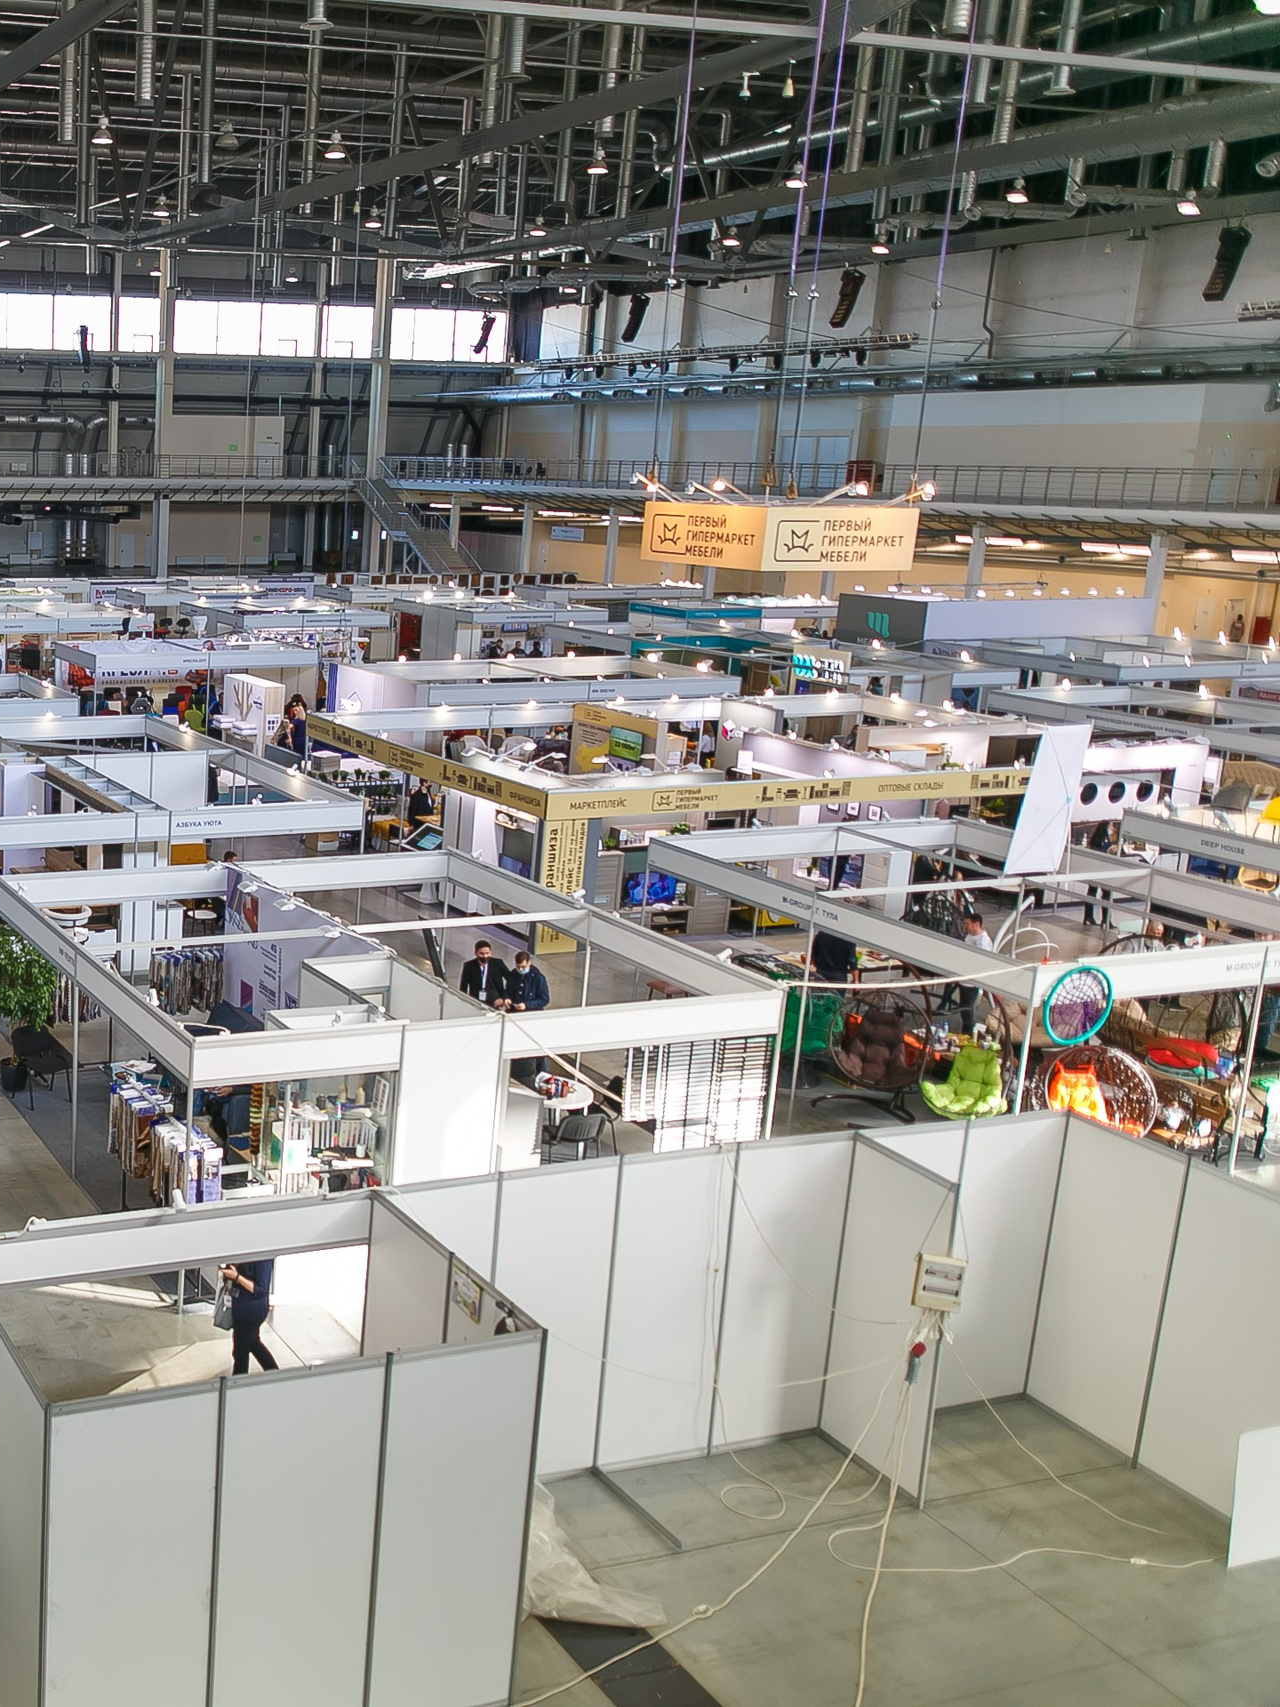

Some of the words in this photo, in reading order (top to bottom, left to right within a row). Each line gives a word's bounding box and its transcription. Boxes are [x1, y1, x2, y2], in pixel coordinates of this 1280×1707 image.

[687, 514, 727, 529] ПЕРВЫЙ
[823, 518, 872, 532] ПЕРВЫЙ
[686, 530, 756, 546] ГИПЕРМАРКЕТ
[821, 535, 905, 548] ГИПЕРМАРКЕТ
[685, 544, 724, 559] МЕБЕЛИ
[820, 550, 867, 562] МЕБЕЛИ
[878, 783, 912, 792] ОПТОВЫЕ
[913, 782, 944, 791] СКЛАДЫ
[509, 791, 541, 808] ФРАНШИЗА
[570, 797, 628, 810] МАРКЕТПЛЕЙС
[676, 795, 719, 803] ГИПЕРМАРКЕТ
[1200, 839, 1220, 849] DEEP
[1221, 844, 1245, 855] HOUSE
[546, 828, 558, 888] раншиза
[782, 896, 812, 910] M-GROUP
[822, 910, 838, 921] ТУЛА
[1226, 961, 1261, 971] M-GROUP
